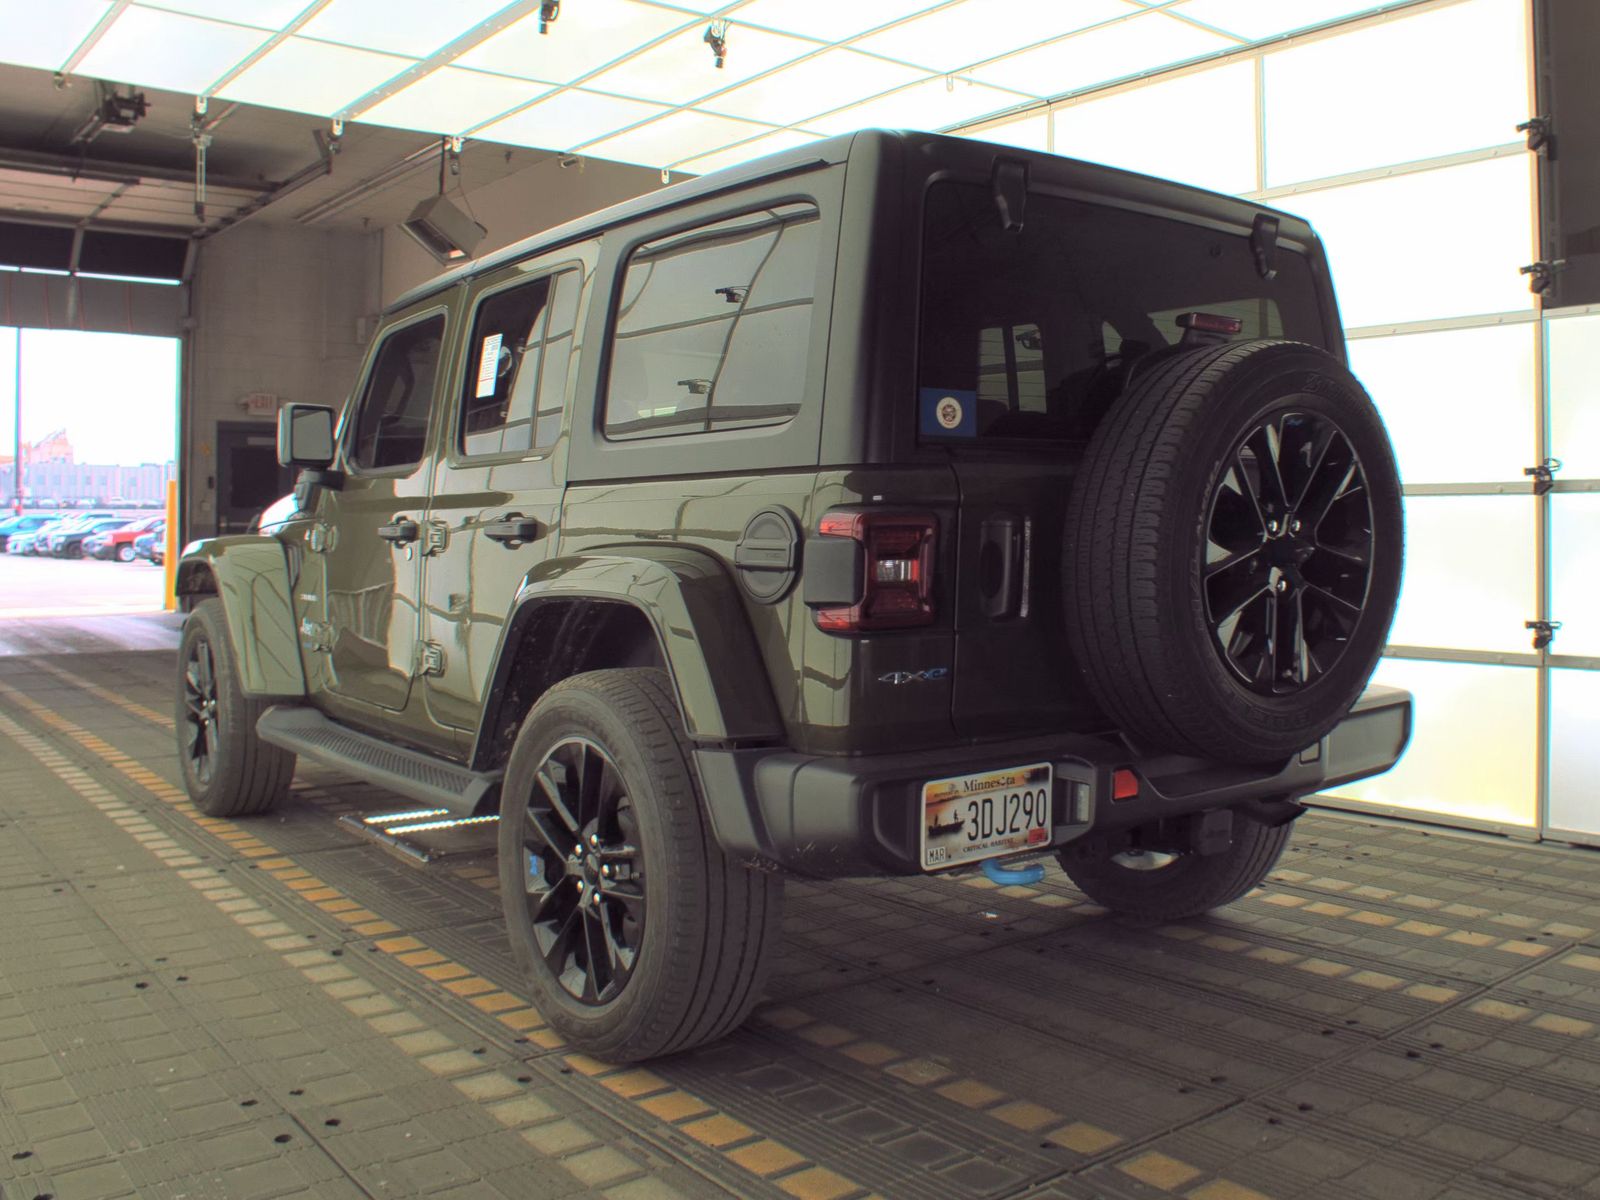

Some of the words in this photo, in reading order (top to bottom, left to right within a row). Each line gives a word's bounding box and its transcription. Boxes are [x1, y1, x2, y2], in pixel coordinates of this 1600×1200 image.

[963, 776, 1016, 793] Minnesota
[967, 788, 1047, 841] 3DJ290
[929, 848, 945, 863] MAR
